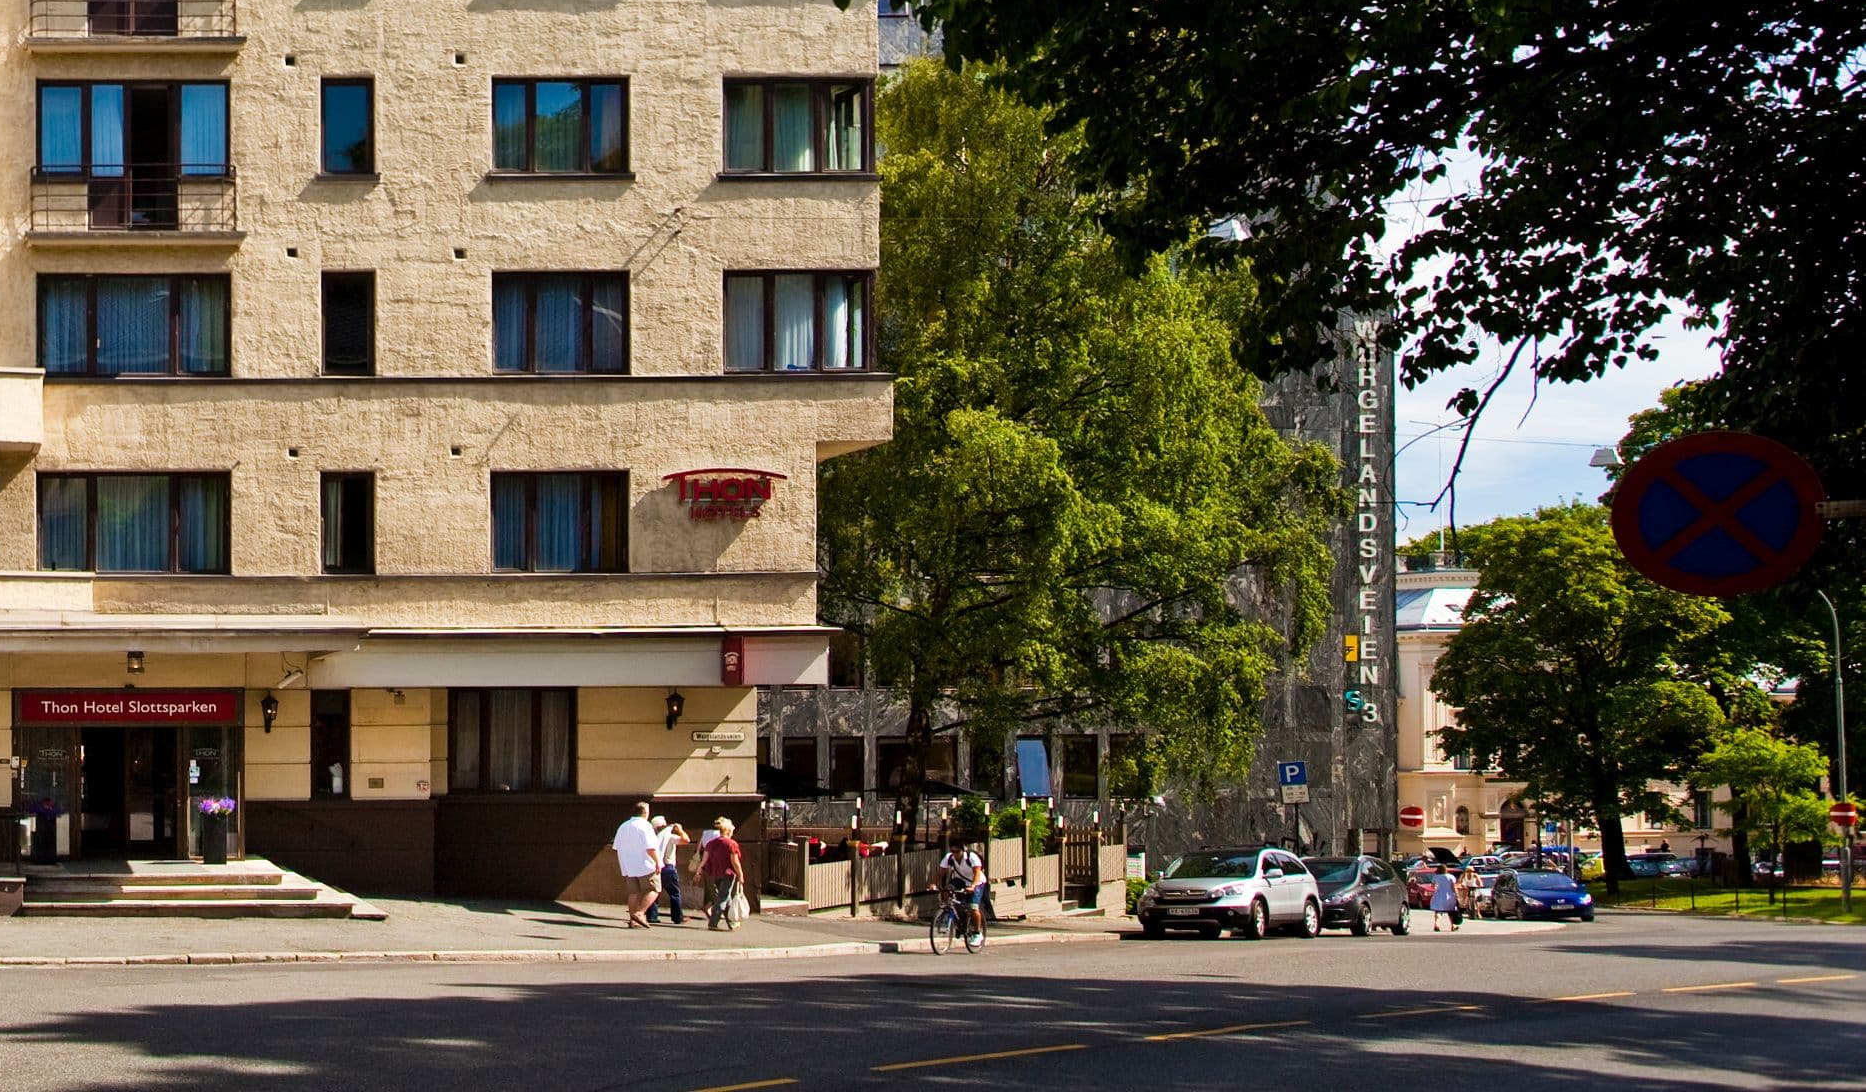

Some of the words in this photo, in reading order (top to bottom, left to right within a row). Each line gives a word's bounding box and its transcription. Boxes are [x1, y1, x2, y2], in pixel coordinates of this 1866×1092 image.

[662, 468, 788, 501] THON
[41, 701, 79, 714] Thon
[83, 701, 124, 714] Hotel
[128, 700, 217, 717] Slottsparken
[1362, 703, 1378, 723] 3
[1285, 765, 1300, 783] P
